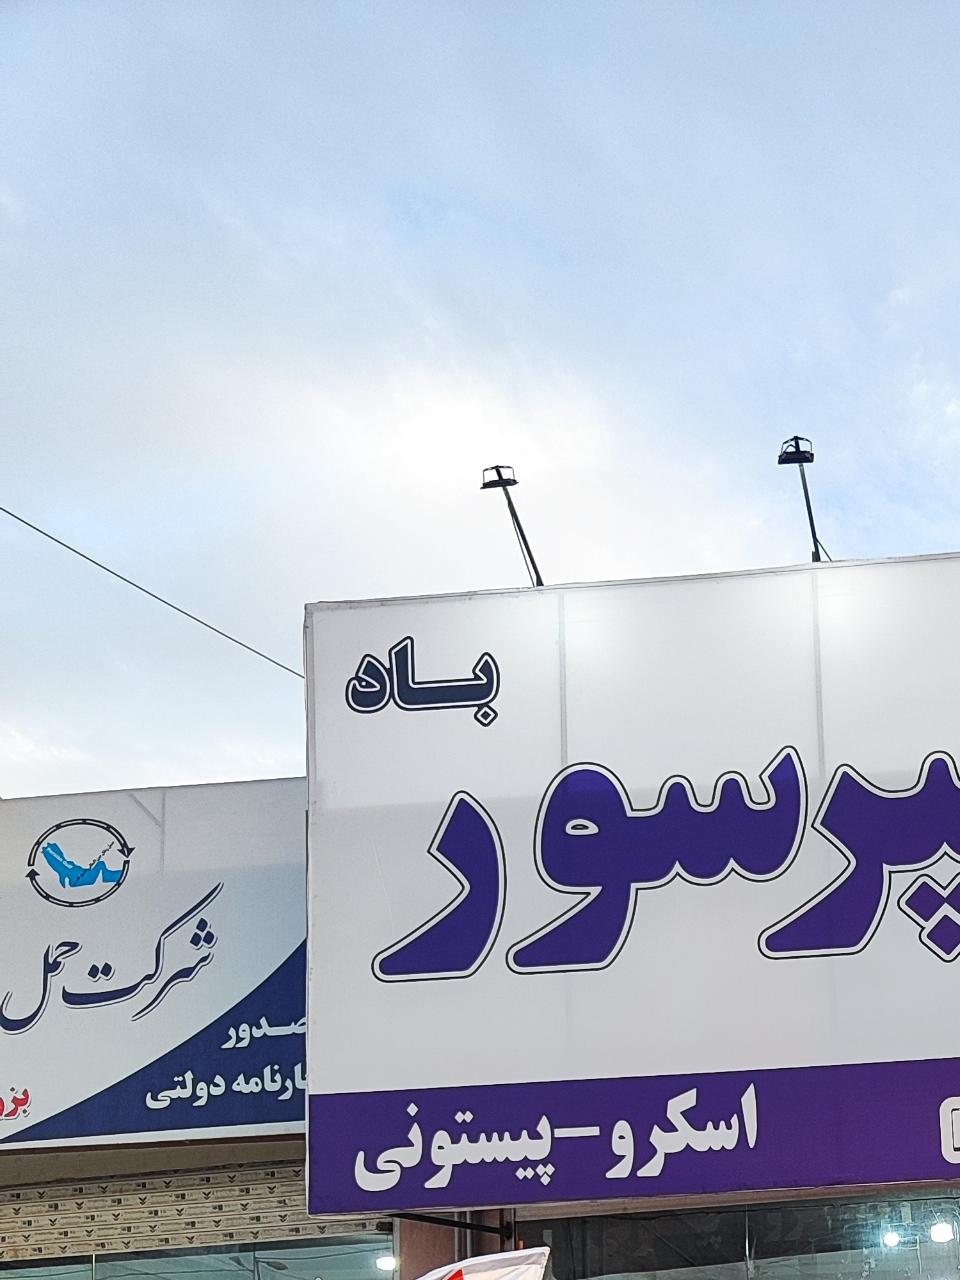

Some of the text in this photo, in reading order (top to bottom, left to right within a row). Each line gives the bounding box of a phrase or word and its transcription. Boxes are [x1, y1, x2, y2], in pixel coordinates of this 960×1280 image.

[345, 634, 501, 728] باد
[0, 882, 224, 1035] شرکت حمل
[145, 1062, 307, 1110] ارنامه دولتی
